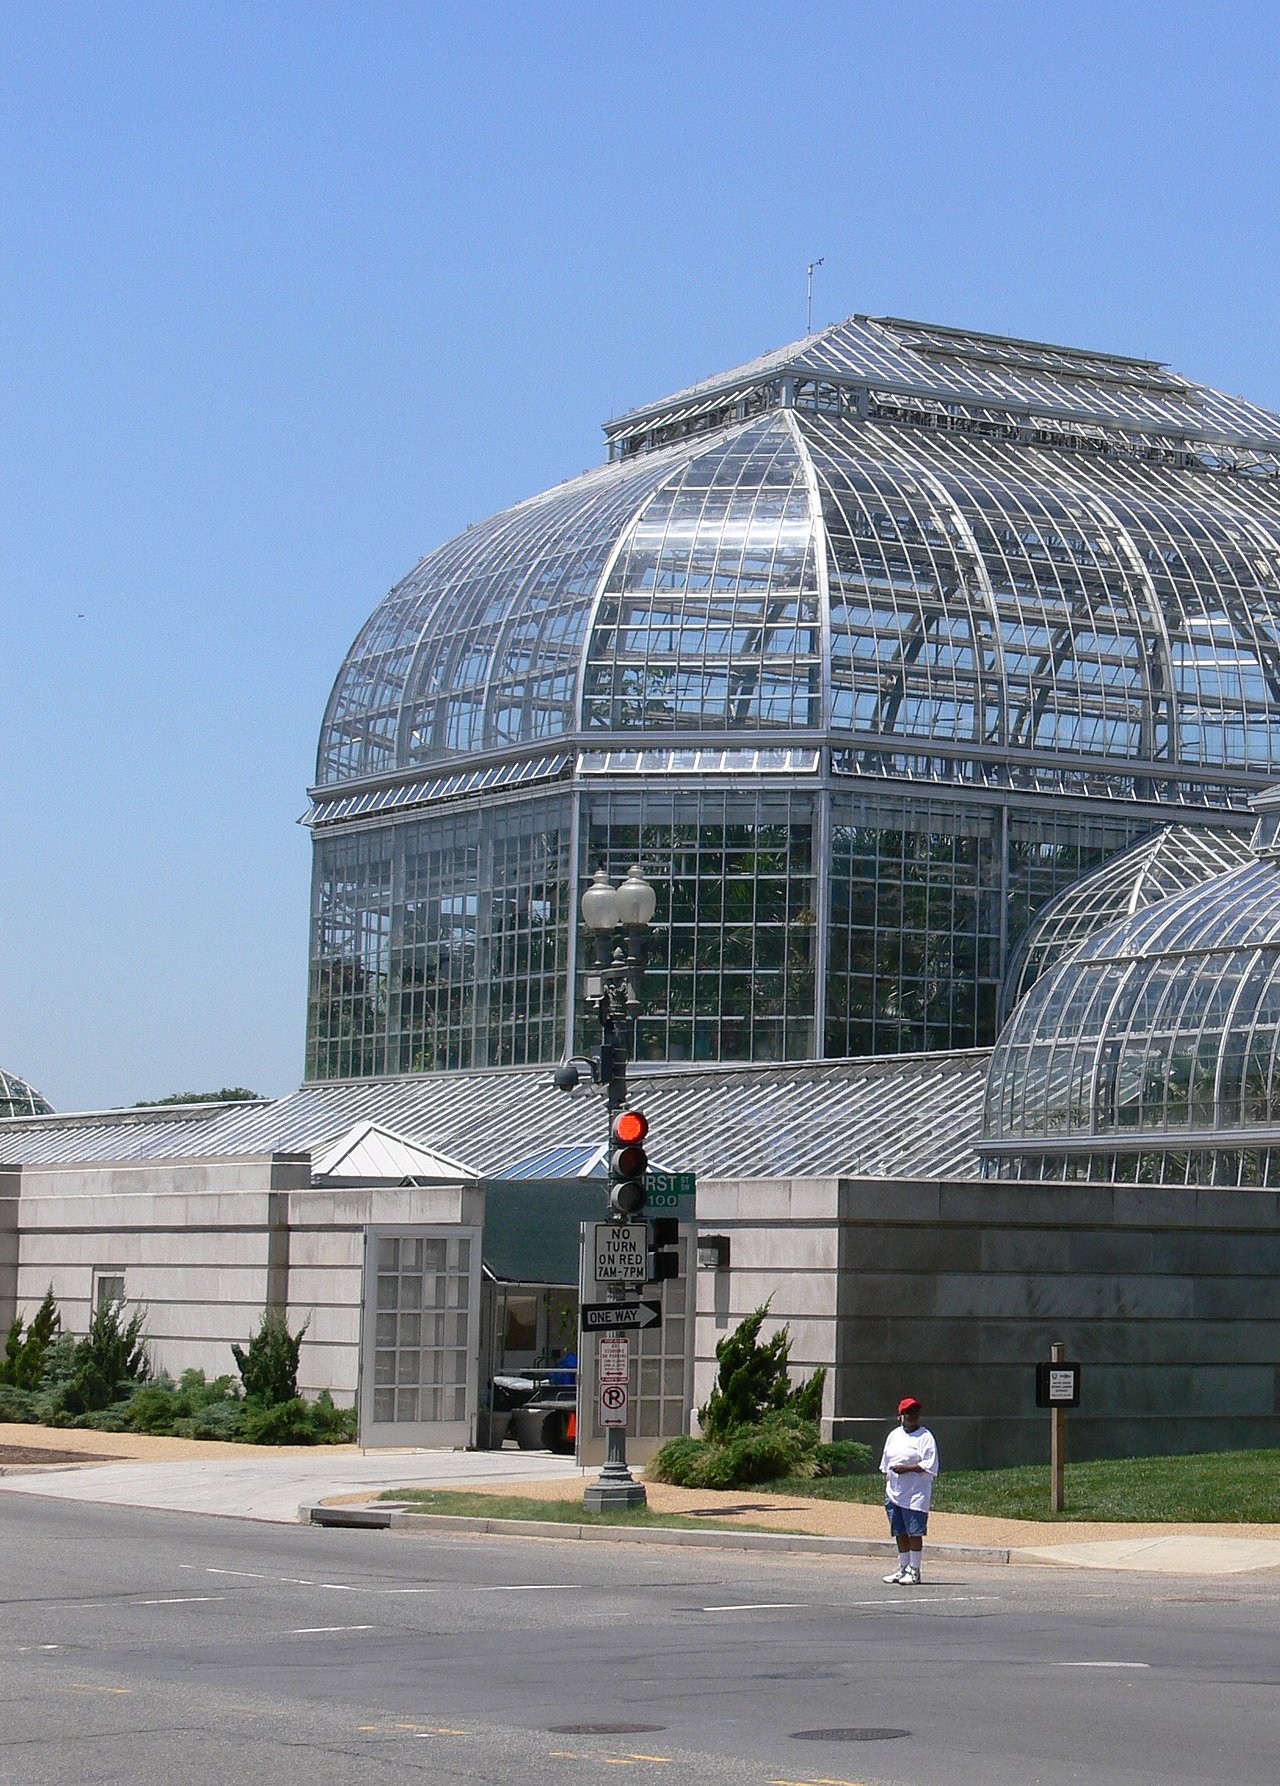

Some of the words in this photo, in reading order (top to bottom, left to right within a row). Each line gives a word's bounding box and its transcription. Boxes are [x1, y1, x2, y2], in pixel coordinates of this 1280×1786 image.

[641, 1175, 677, 1191] IRST
[648, 1195, 677, 1206] 100
[611, 1229, 631, 1240] NO
[605, 1241, 637, 1252] TURN
[598, 1254, 615, 1265] ON
[619, 1254, 643, 1265] RED
[597, 1267, 644, 1278] 7AM-7PM
[589, 1311, 612, 1323] ONE
[614, 1309, 638, 1322] WAY
